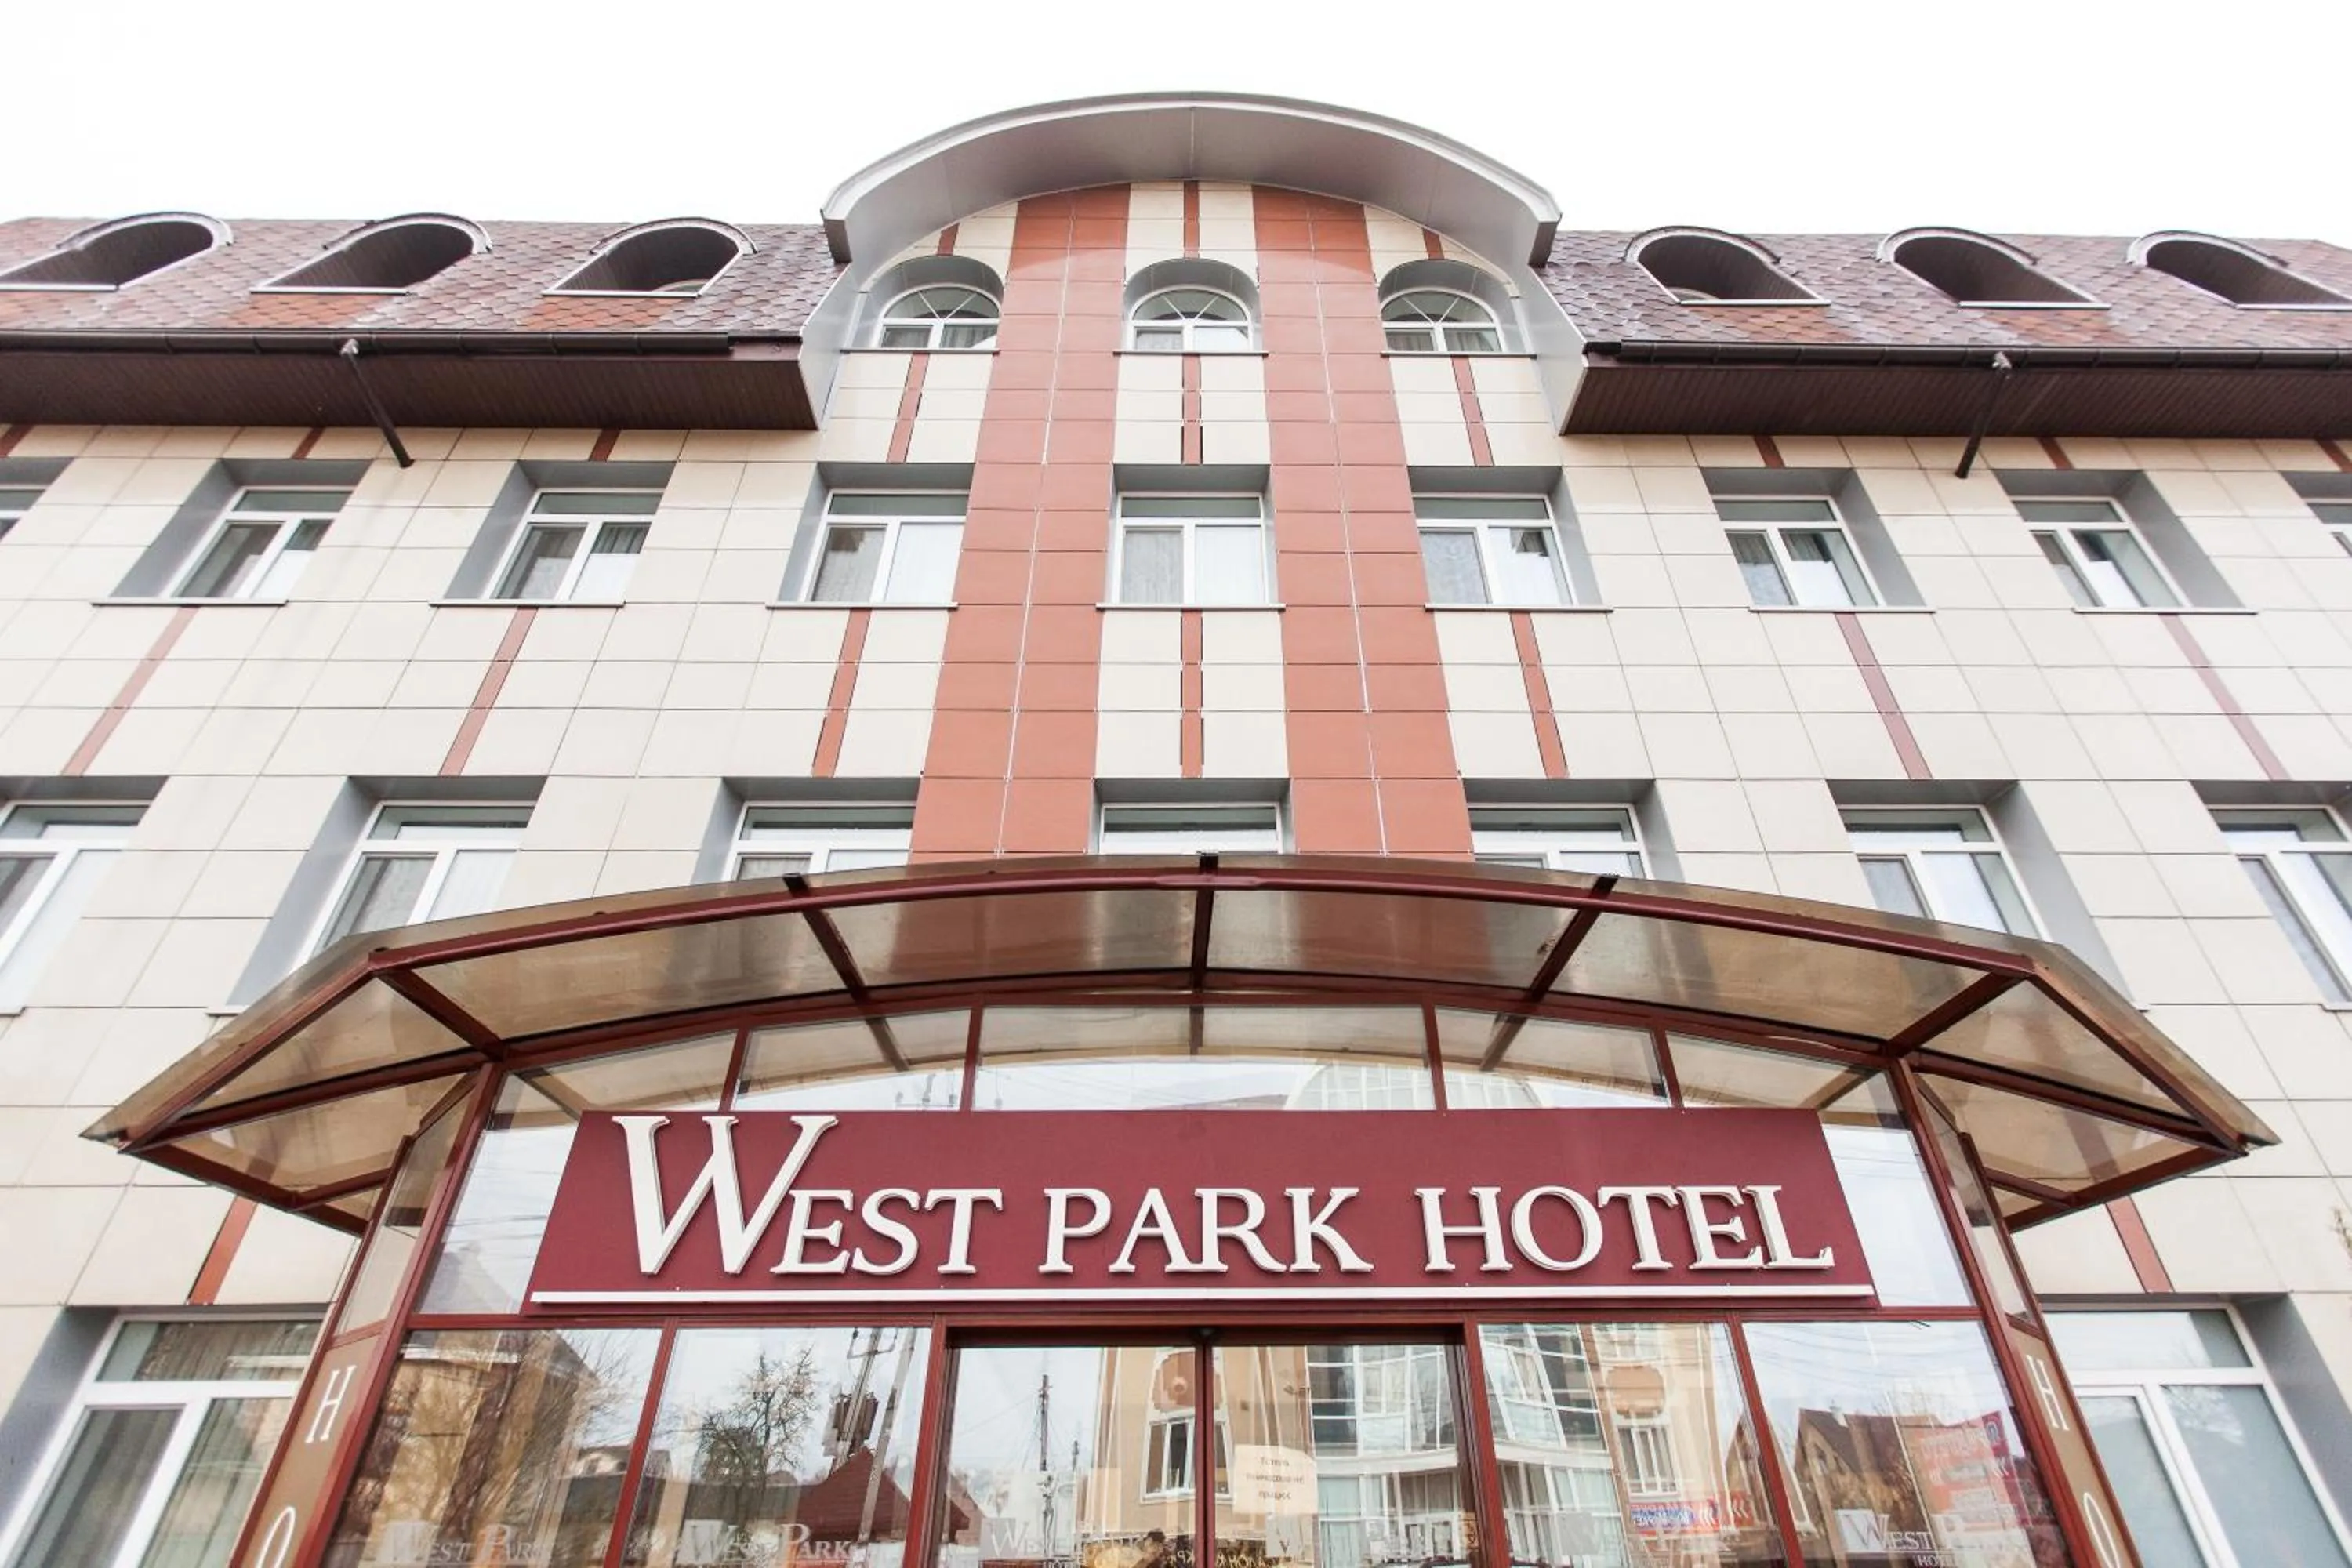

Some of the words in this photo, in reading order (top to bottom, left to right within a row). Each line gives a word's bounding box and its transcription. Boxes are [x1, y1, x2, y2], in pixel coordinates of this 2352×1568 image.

[612, 1115, 1004, 1275] WEST
[1038, 1187, 1374, 1273] PARK
[1414, 1185, 1835, 1272] HOTEL
